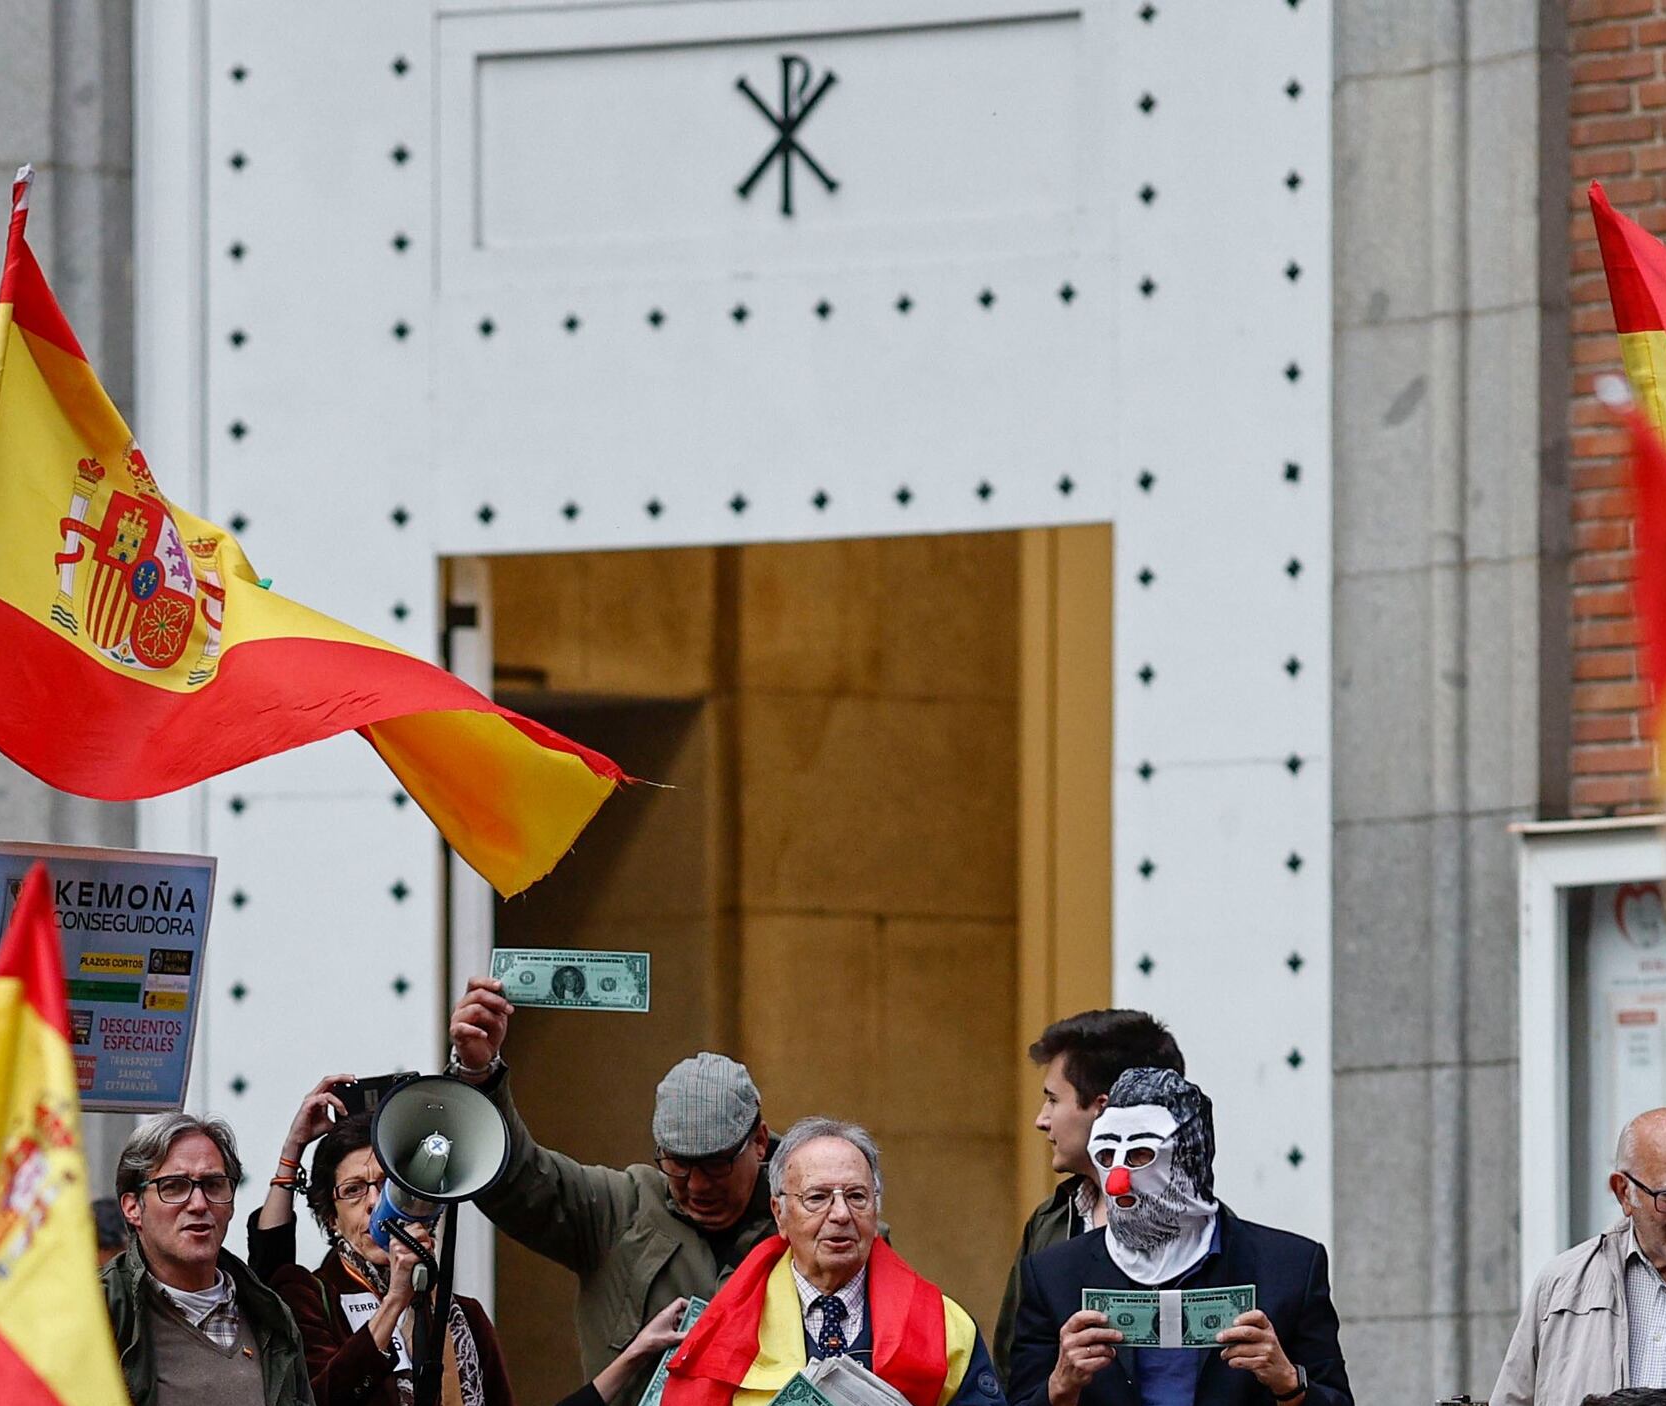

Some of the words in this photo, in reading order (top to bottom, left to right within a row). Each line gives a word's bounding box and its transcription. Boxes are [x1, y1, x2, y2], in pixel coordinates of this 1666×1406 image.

[55, 880, 196, 914] KEMOÑA
[52, 910, 195, 937] CONSEGUIDORA
[80, 956, 110, 967] PLAZOS
[112, 958, 143, 969] CORTOS
[99, 1017, 182, 1036] DESCUENTOS
[103, 1035, 175, 1052] ESPECIALES
[348, 1302, 380, 1312] FERRA
